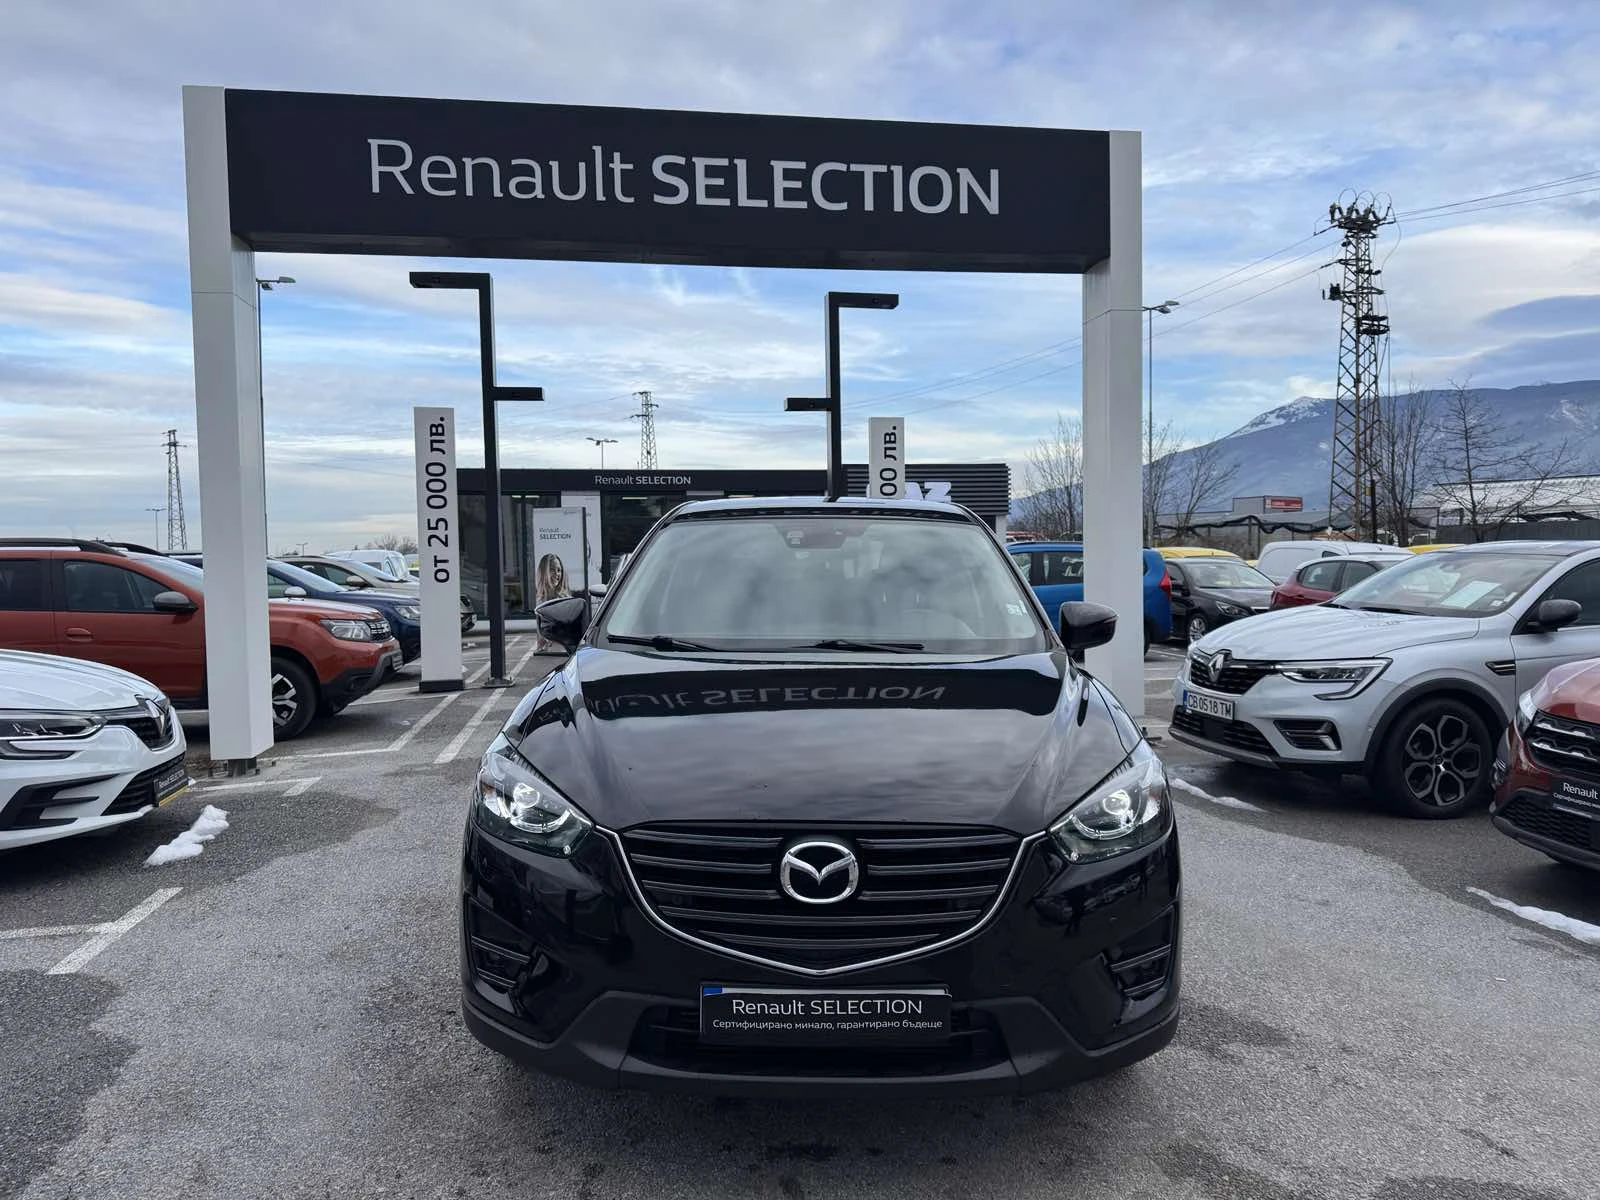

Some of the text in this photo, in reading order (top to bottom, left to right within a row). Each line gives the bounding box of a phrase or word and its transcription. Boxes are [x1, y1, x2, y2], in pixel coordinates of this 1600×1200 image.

[367, 137, 1001, 216] Renault SELECTION
[880, 425, 898, 497] 00 лв.
[594, 475, 691, 485] Renault SELECTION
[425, 416, 451, 583] от 25 000 лв.
[1199, 696, 1218, 714] 0518
[1563, 782, 1599, 800] Renault
[732, 999, 923, 1015] Renault SELECTION
[712, 1018, 944, 1030] Сертифицирано минало, гарантирано бъдеще
